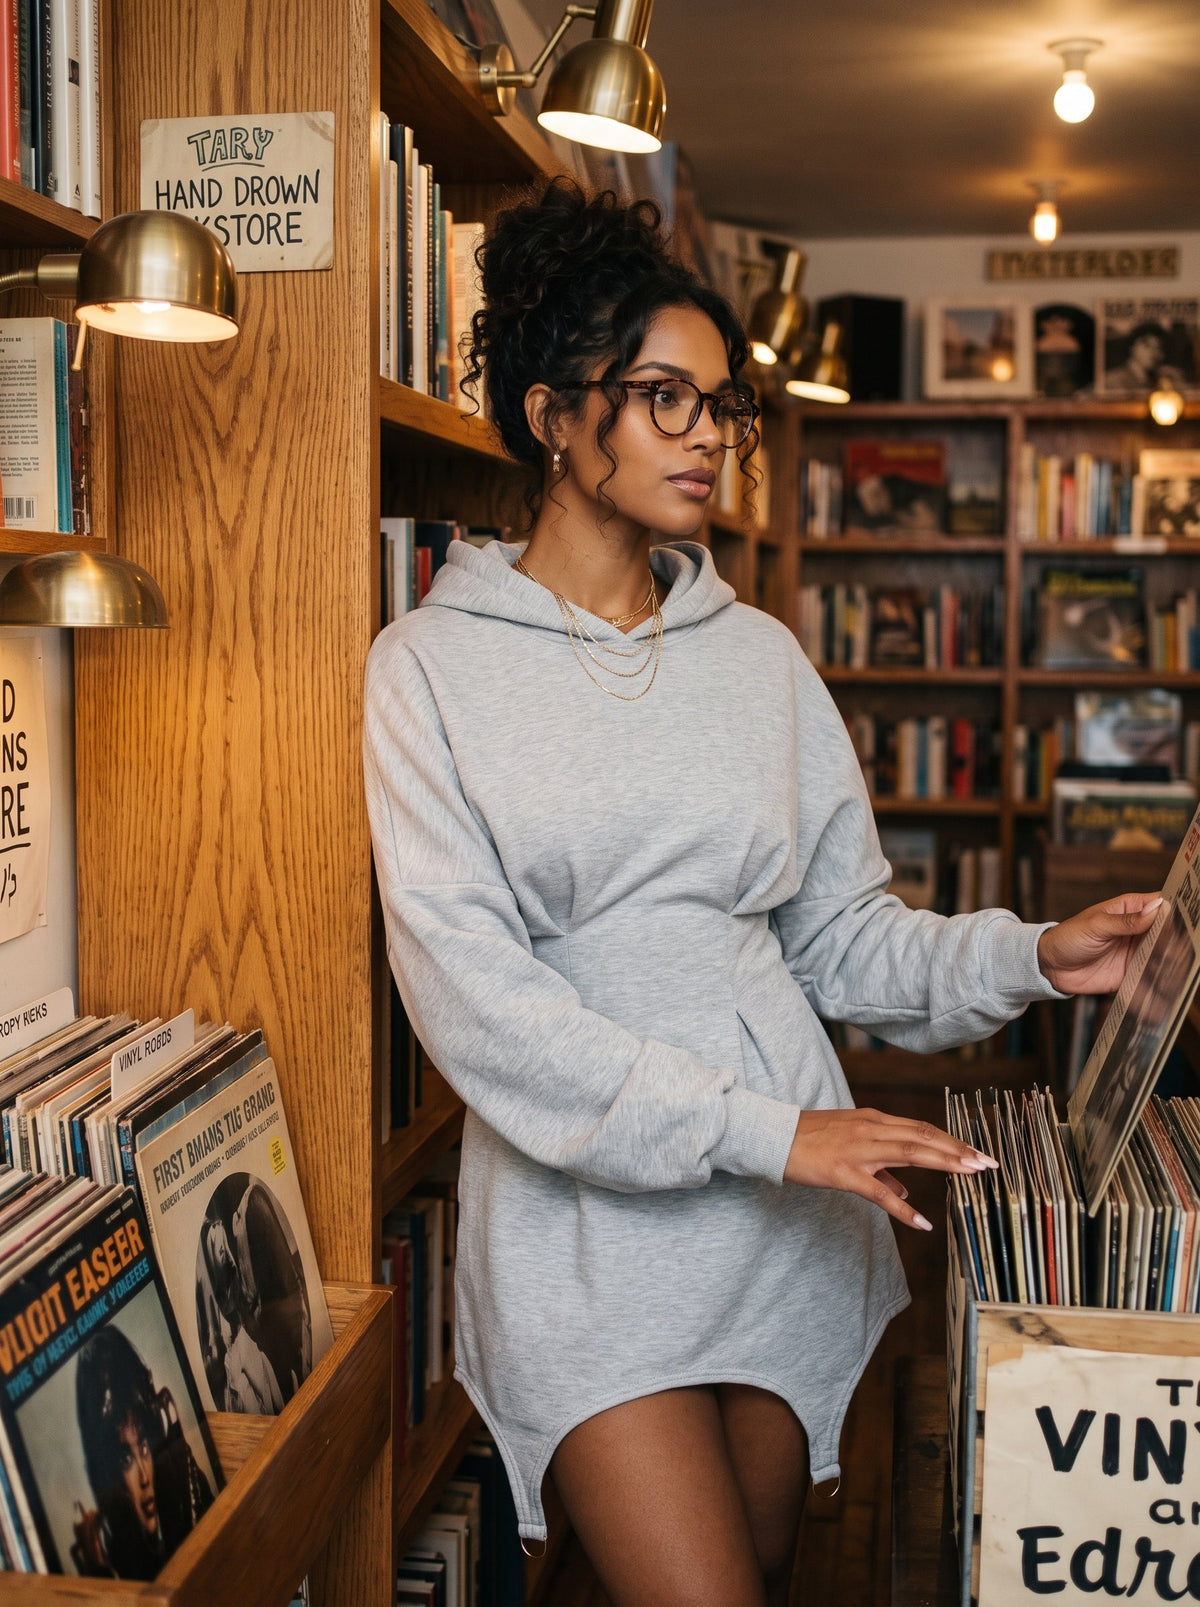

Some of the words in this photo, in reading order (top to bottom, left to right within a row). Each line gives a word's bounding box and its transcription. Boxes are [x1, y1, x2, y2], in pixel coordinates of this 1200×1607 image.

[187, 127, 273, 166] TARY
[156, 178, 222, 210] HAND
[235, 169, 320, 206] DROWN
[2, 679, 16, 723] D
[118, 1045, 142, 1072] VINYL
[152, 1147, 185, 1194] FIRST
[1035, 1405, 1200, 1484] VIN
